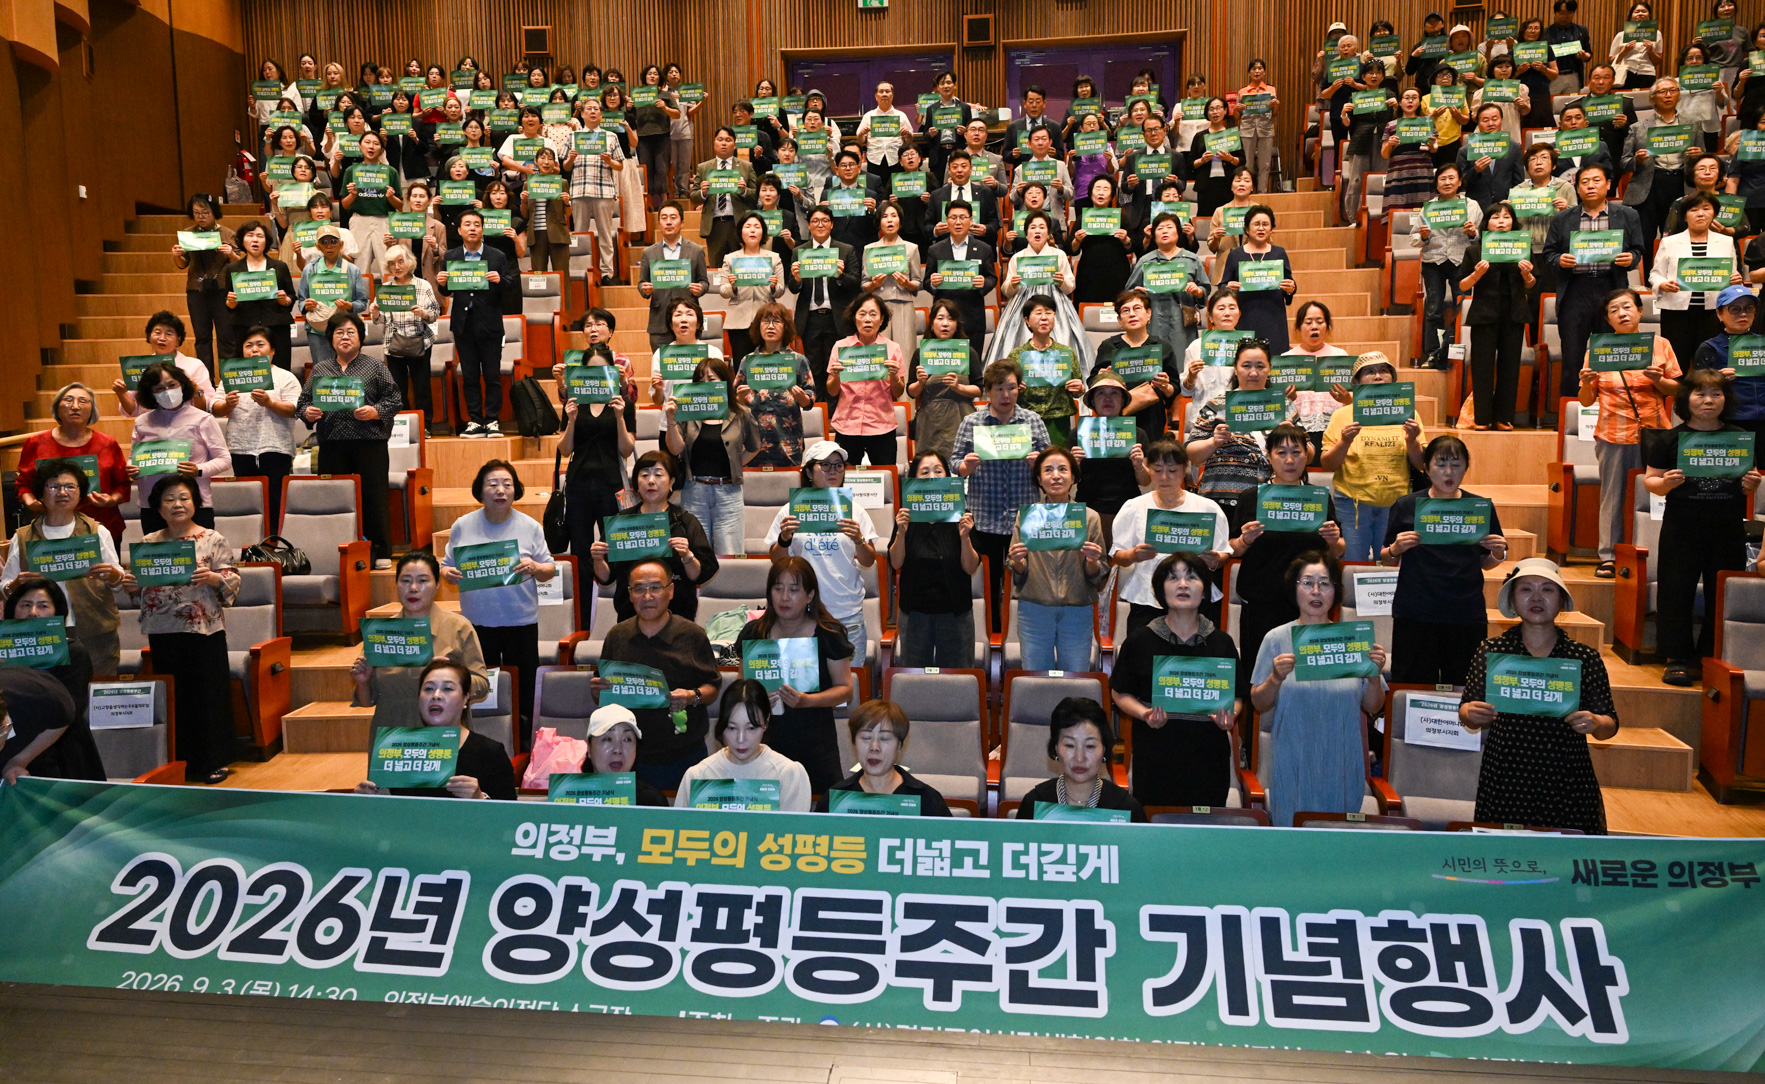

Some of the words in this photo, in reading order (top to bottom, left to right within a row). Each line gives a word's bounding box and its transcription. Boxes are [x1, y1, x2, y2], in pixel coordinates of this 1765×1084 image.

[1282, 502, 1301, 510] 모두의
[629, 530, 646, 539] 모두의
[1322, 643, 1345, 653] 모두의
[1306, 655, 1315, 666] 더
[1334, 653, 1343, 664] 더
[1182, 677, 1204, 687] 모두의
[1520, 677, 1545, 688] 모두의
[1164, 687, 1173, 697] 더
[1192, 689, 1201, 699] 더
[1500, 686, 1509, 697] 더
[1532, 689, 1541, 700] 더
[403, 748, 427, 758] 모두의
[383, 760, 393, 771] 더
[412, 760, 422, 771] 더
[511, 822, 625, 864] 의정부,
[637, 829, 748, 868] 모두의
[758, 834, 867, 874] 성평등
[878, 838, 990, 878] 더넓고
[1002, 842, 1120, 884] 더깊게
[1442, 857, 1486, 873] 시민의
[1493, 857, 1547, 876] 뜻으로,
[1571, 859, 1659, 889] 새로운
[1667, 861, 1760, 889] 의정부
[91, 855, 468, 972] 2026년
[487, 877, 1111, 1013] 양성평등주간
[1145, 909, 1626, 1039] 기념행사
